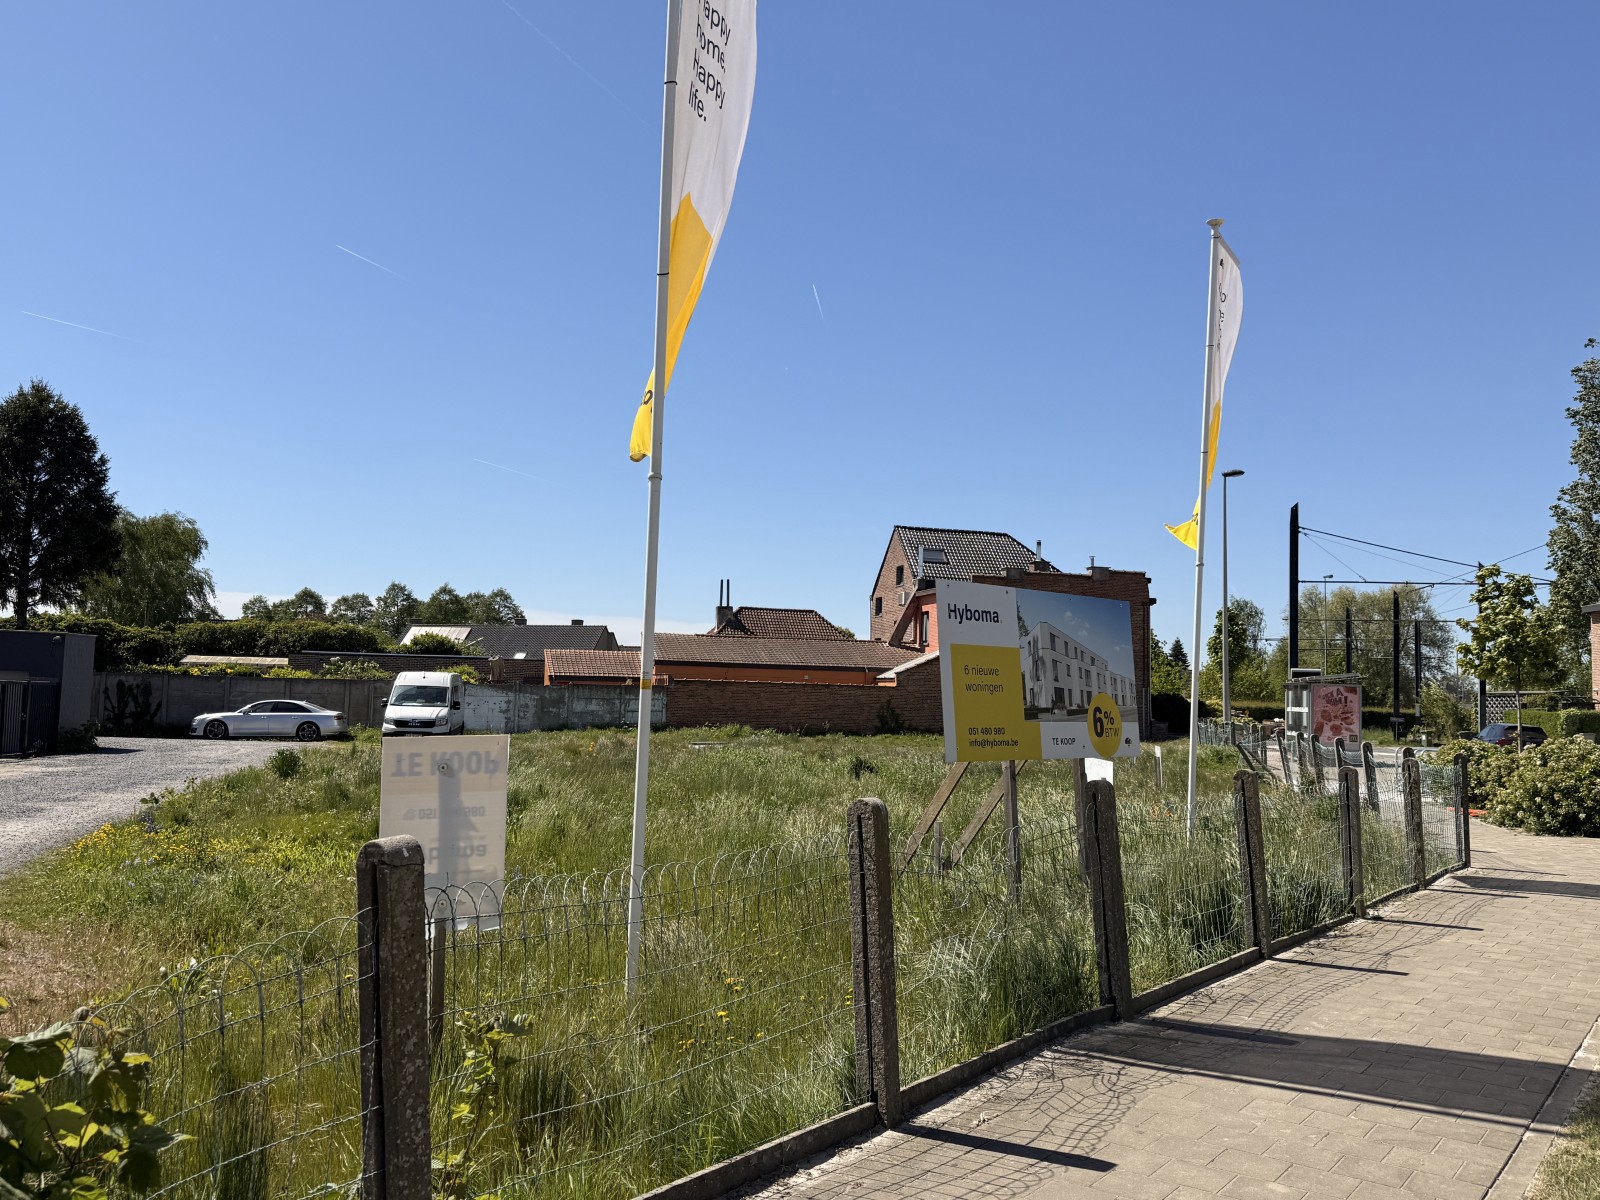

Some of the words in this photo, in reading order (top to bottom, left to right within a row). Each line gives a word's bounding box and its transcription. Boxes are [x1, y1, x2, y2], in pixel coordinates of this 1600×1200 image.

[688, 80, 707, 122] life.
[964, 664, 969, 676] 6
[971, 665, 1000, 677] nieuwe
[965, 681, 1004, 695] woningen
[968, 727, 979, 736] 051
[1105, 727, 1120, 738] BTW
[968, 738, 1019, 749] info@hyboma.be
[1052, 738, 1060, 746] TE
[1060, 737, 1076, 746] KOOP
